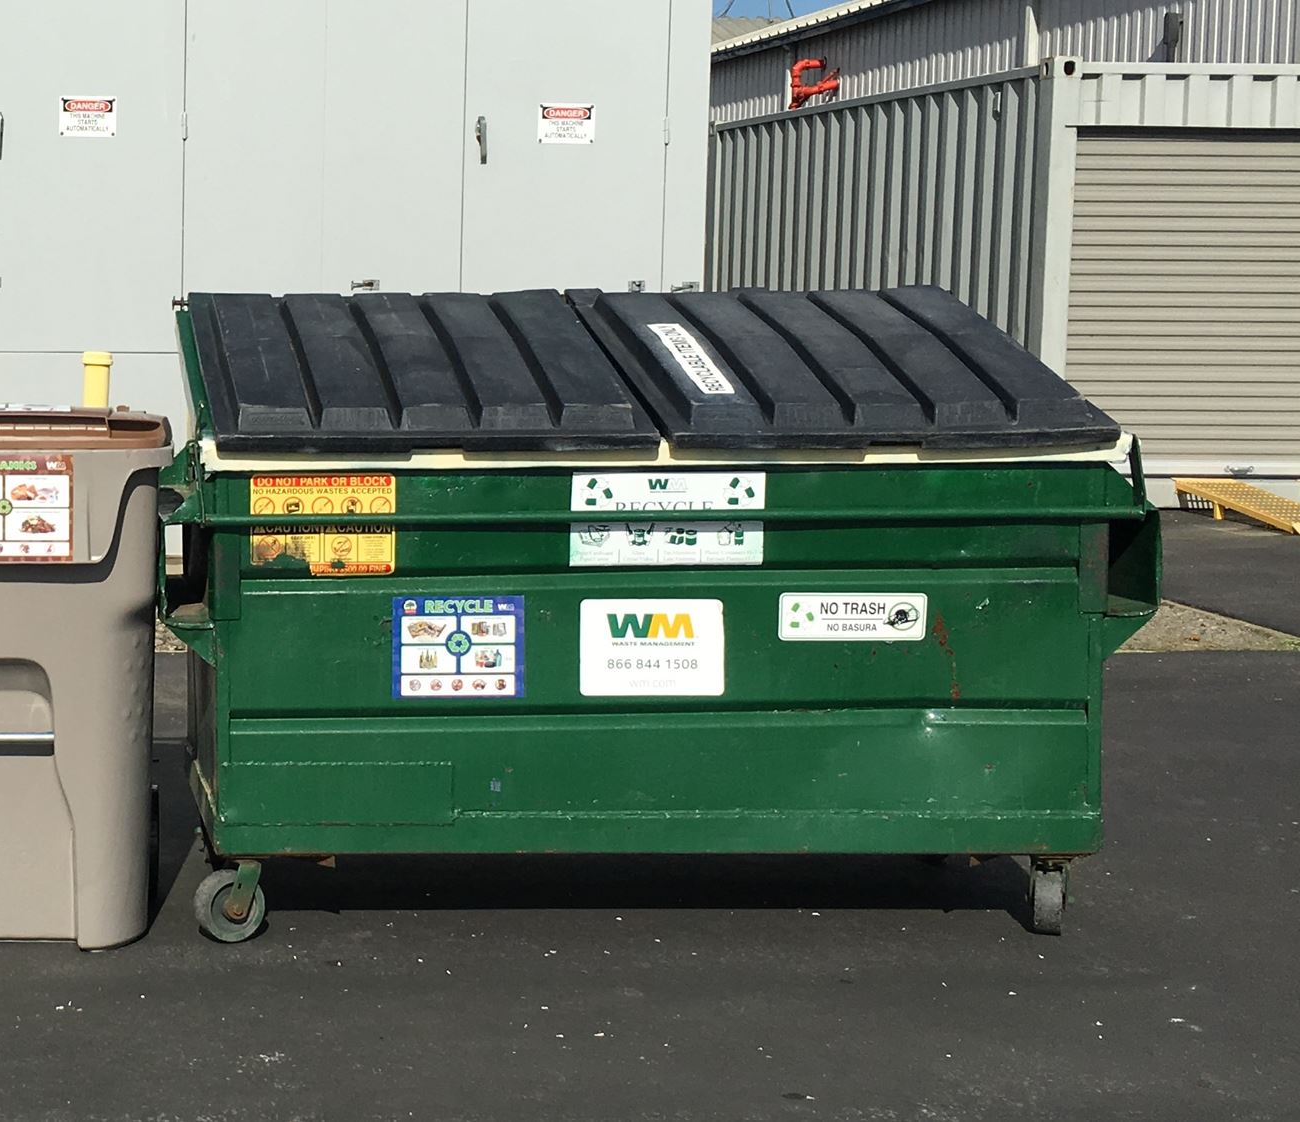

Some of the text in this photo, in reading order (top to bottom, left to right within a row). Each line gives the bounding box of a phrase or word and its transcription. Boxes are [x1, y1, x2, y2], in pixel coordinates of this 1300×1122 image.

[70, 102, 106, 110] DANGER
[549, 109, 584, 117] DANGER
[257, 477, 387, 486] DO NOT PARK OR BLOCK
[266, 525, 320, 533] CAUTION
[337, 525, 391, 533] CAUTION
[425, 600, 493, 613] RECYCLE
[820, 602, 886, 615] NO TRASH
[606, 613, 694, 638] WM
[827, 623, 877, 632] NO BASURA
[607, 659, 698, 669] 866 844 1508
